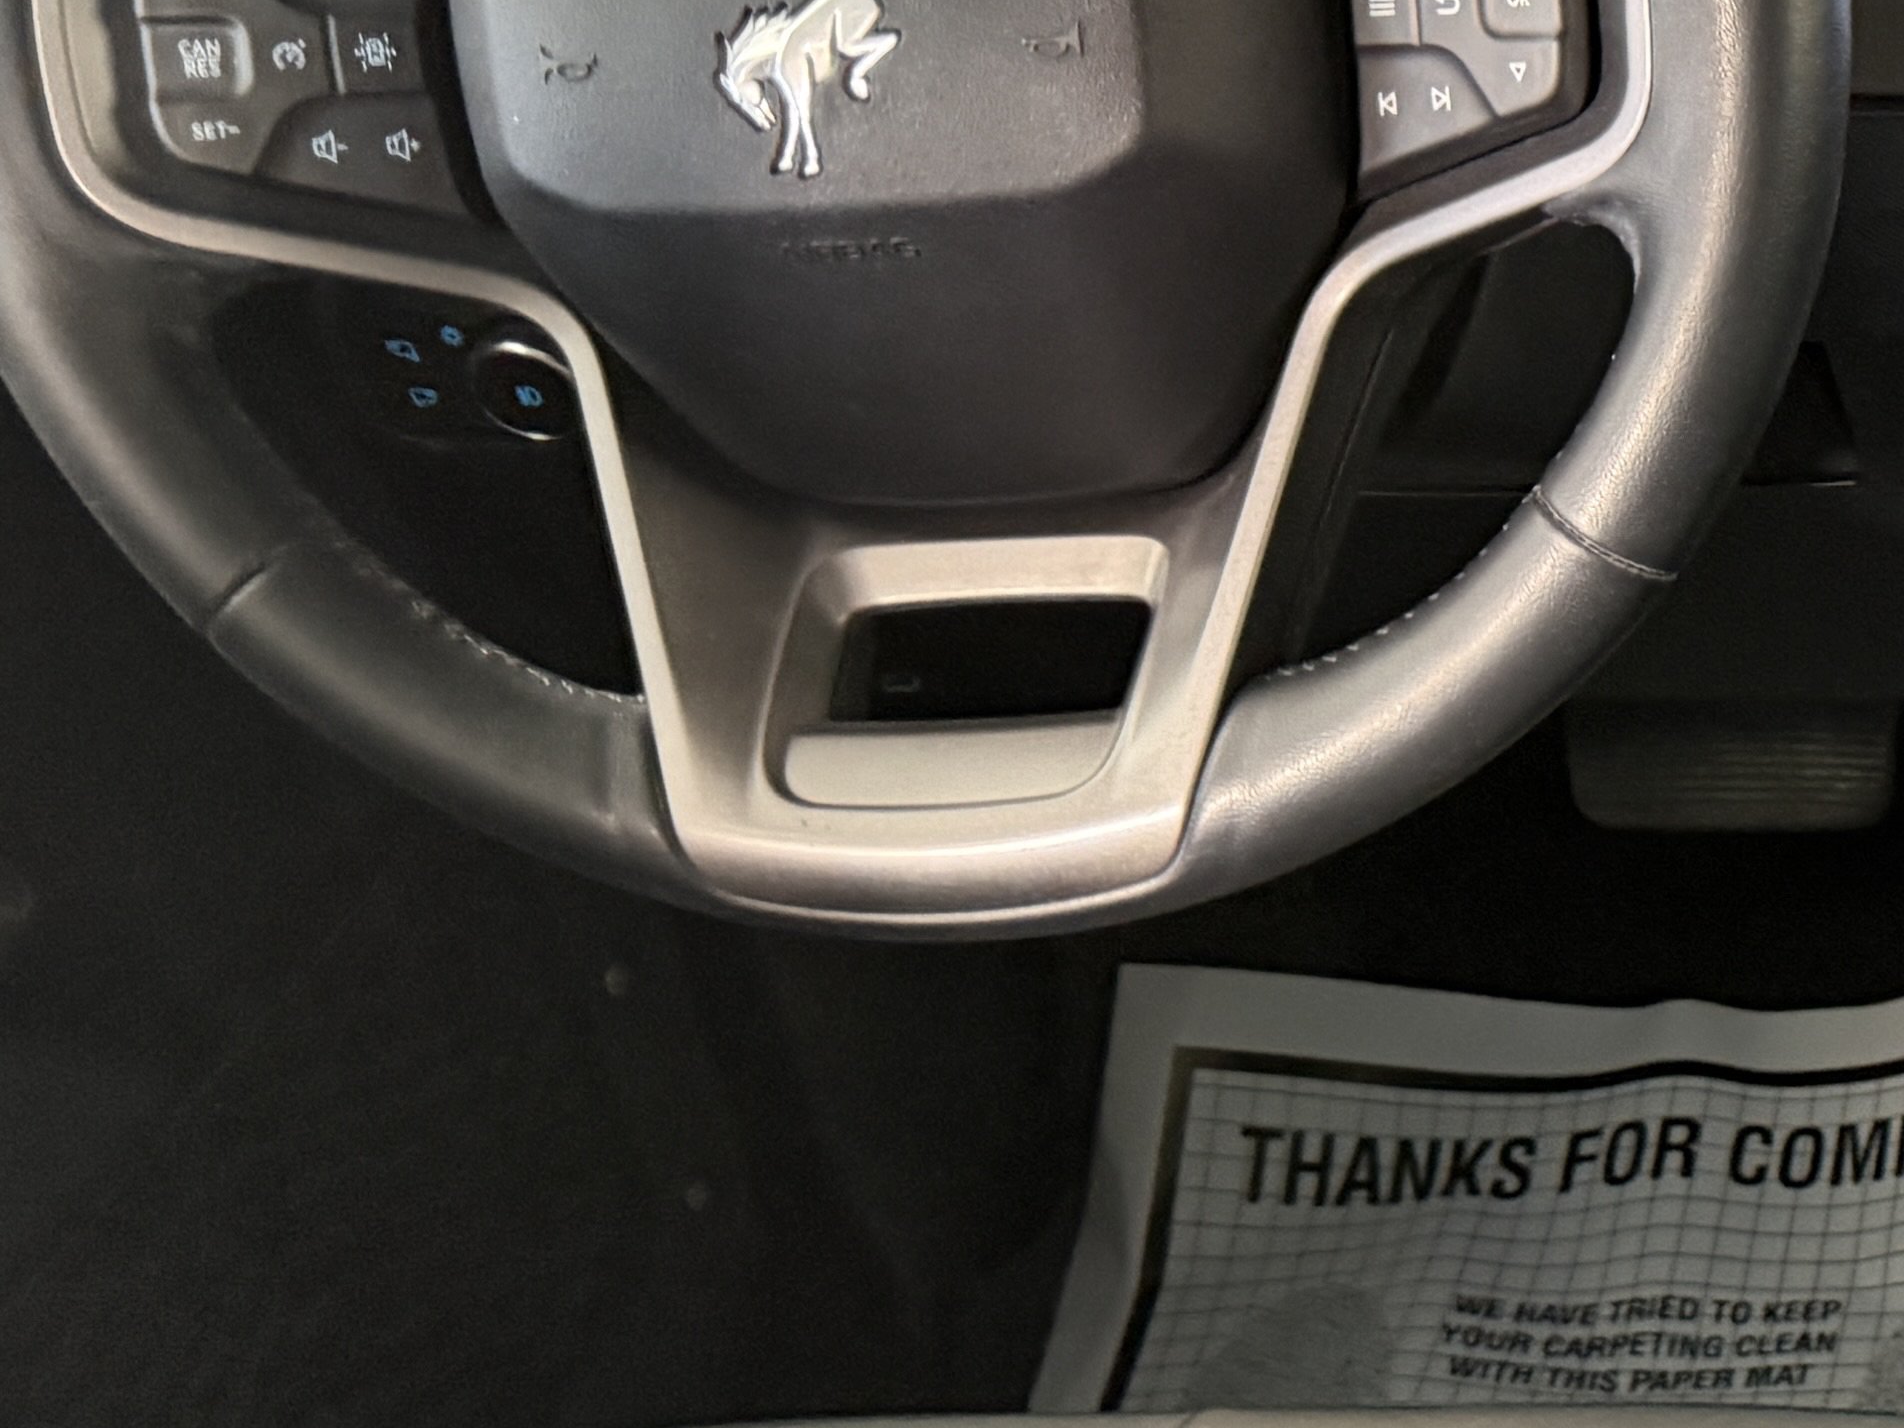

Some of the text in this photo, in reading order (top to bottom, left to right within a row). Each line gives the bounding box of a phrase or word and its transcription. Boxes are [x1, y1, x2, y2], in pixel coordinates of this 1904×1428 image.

[177, 38, 221, 57] CAN
[1239, 1125, 1538, 1207] THANKS
[1557, 1115, 1700, 1195] FOR
[1454, 1293, 1843, 1327] WE HAVE TRIED TO KEEP
[1441, 1322, 1838, 1359] YOUR CARPETING CLEAN
[1447, 1356, 1815, 1394] WITH THIS PAPER MAT
